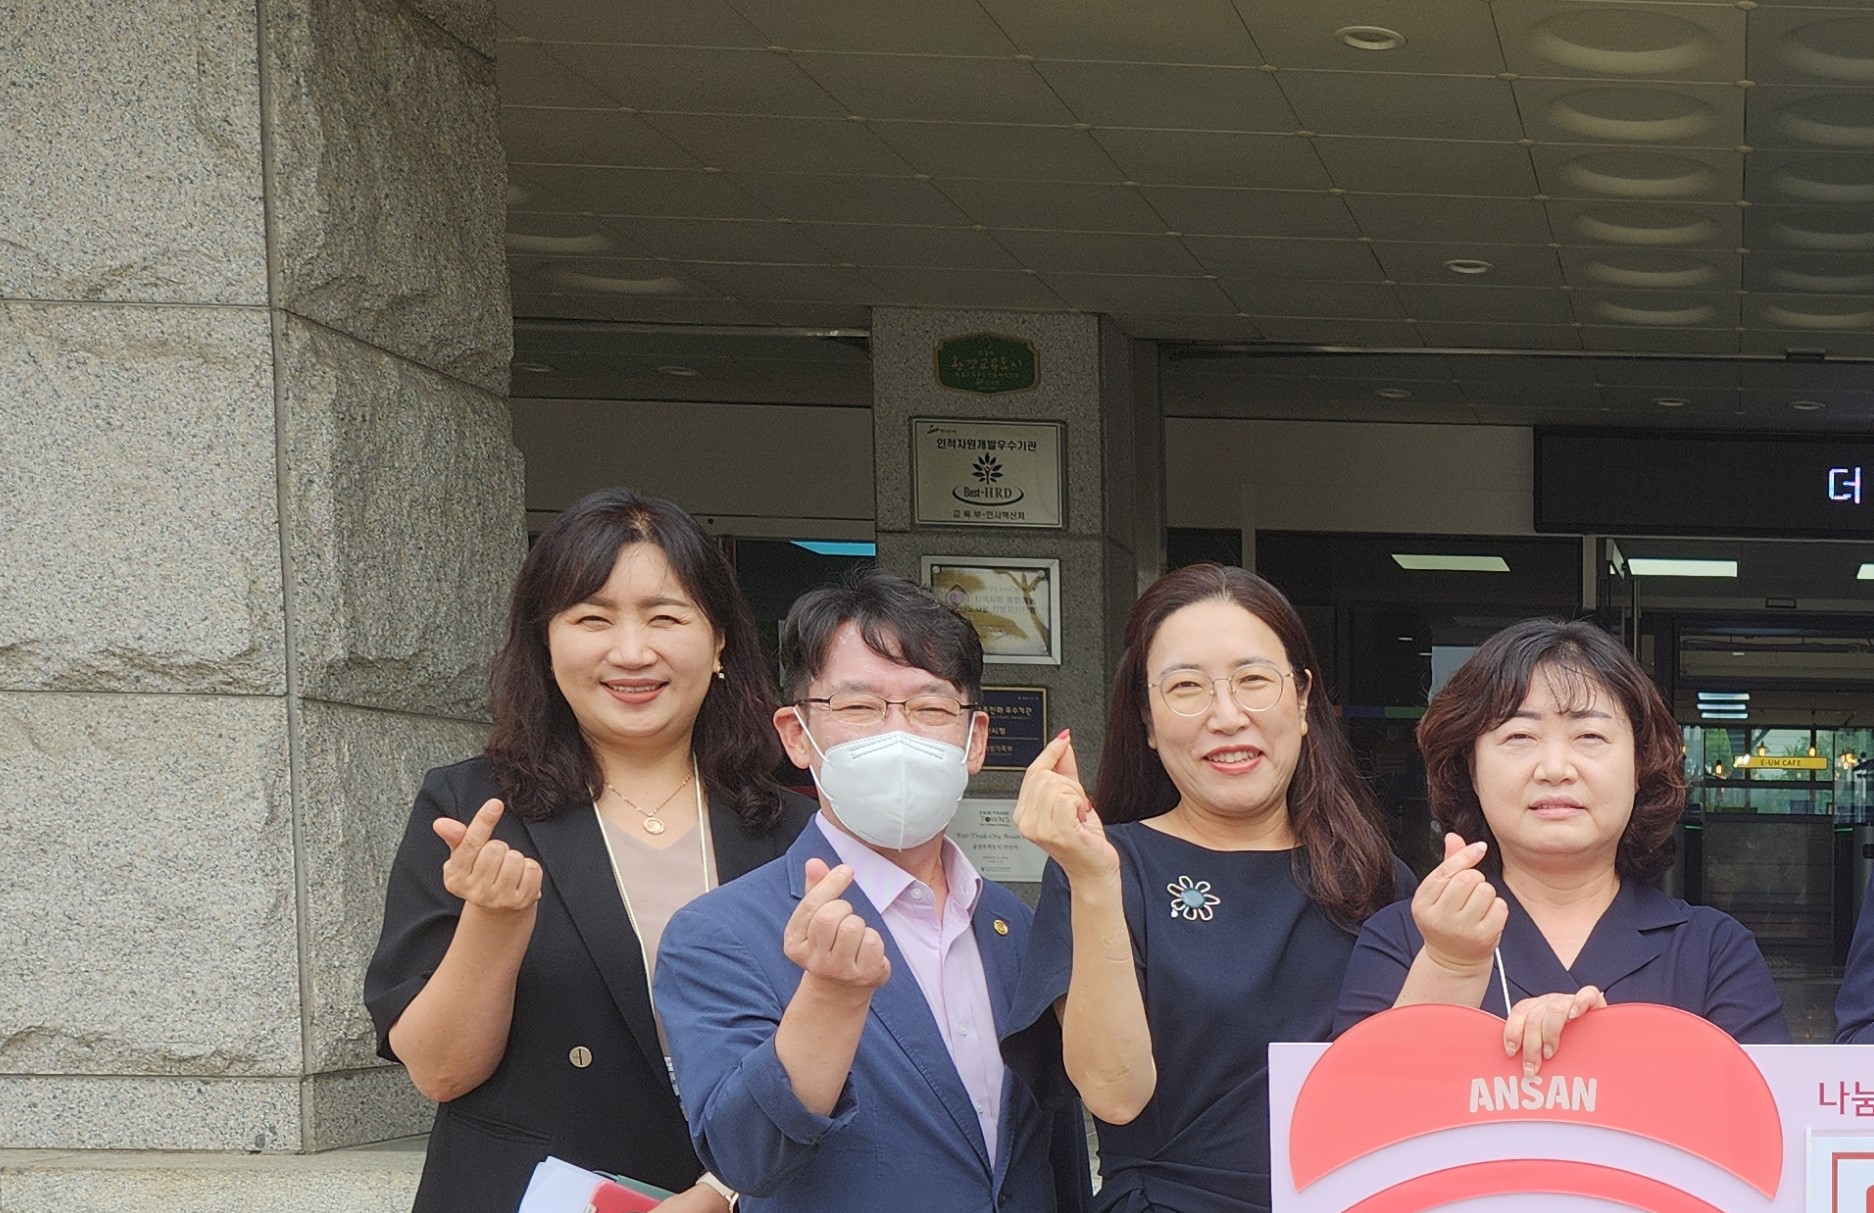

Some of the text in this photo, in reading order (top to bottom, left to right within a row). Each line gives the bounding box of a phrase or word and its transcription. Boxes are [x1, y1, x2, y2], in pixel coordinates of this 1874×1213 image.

[936, 438, 1037, 452] 인적자원개발우수기관
[1828, 466, 1861, 505] 더
[1469, 1075, 1598, 1113] ANSAN
